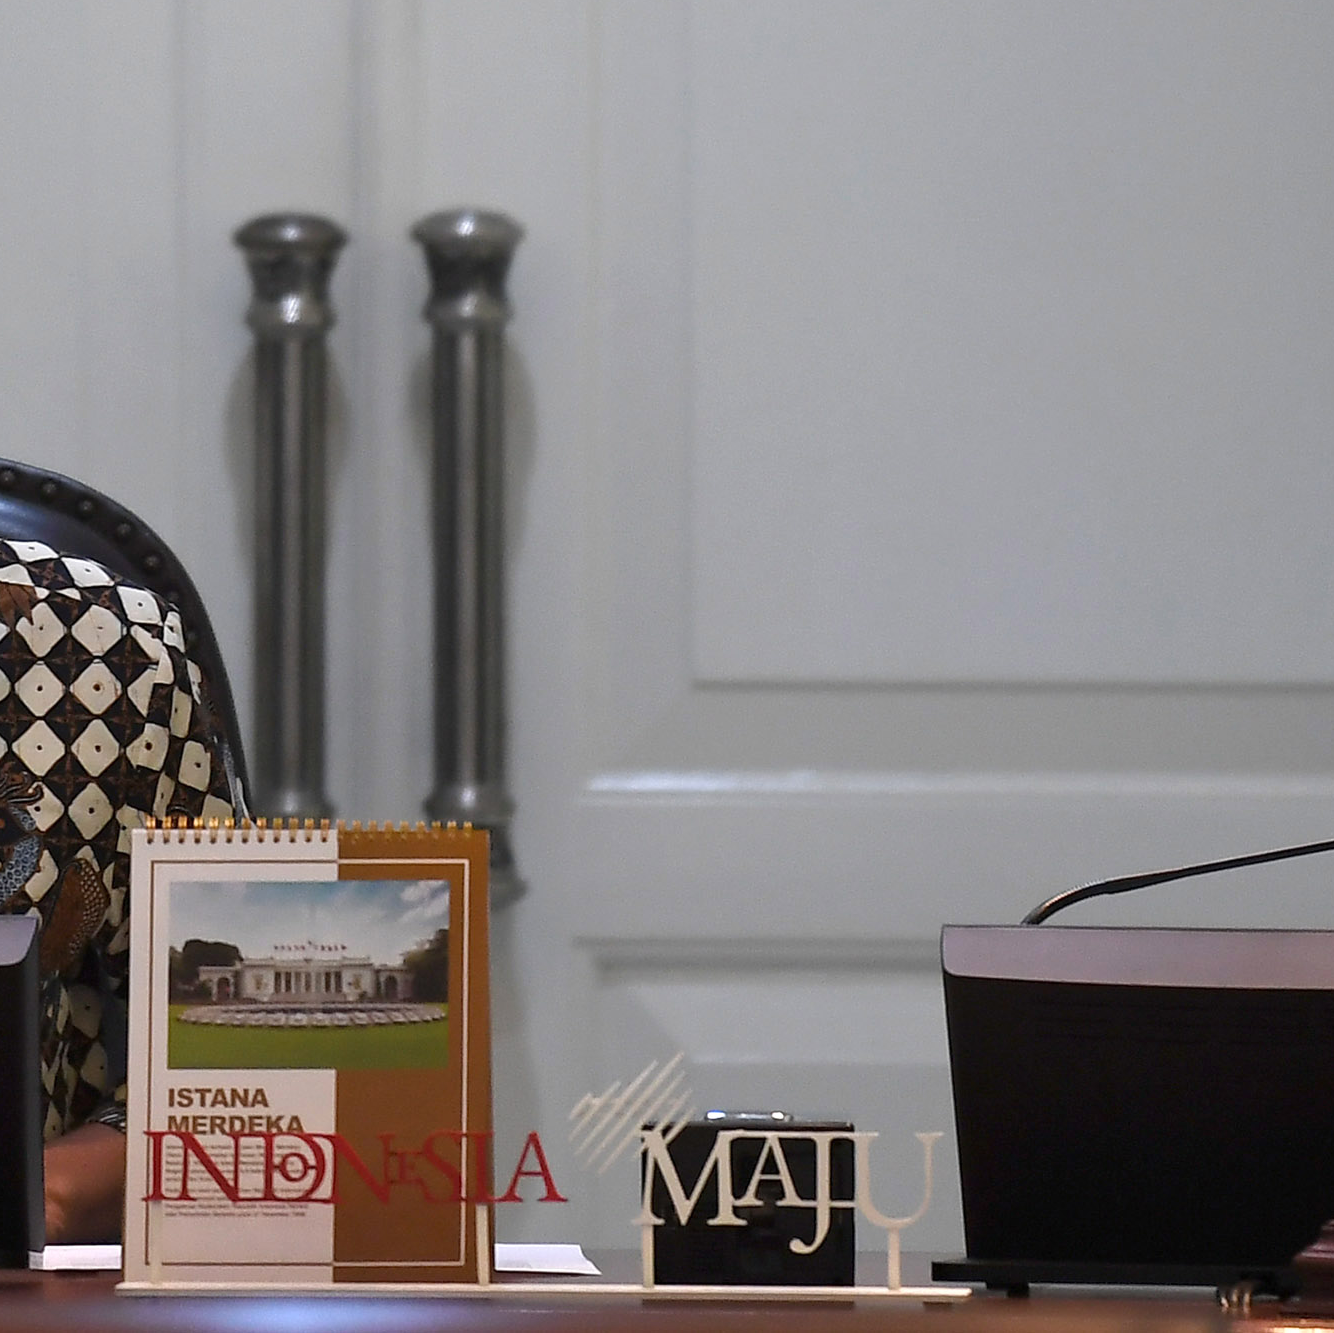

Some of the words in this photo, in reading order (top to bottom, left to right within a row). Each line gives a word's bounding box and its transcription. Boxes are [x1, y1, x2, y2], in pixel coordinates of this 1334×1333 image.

[168, 1088, 269, 1108] ISTANA
[167, 1115, 305, 1134] MERDEKA
[142, 1130, 568, 1204] INDONESIA
[632, 1130, 944, 1254] MAJU
